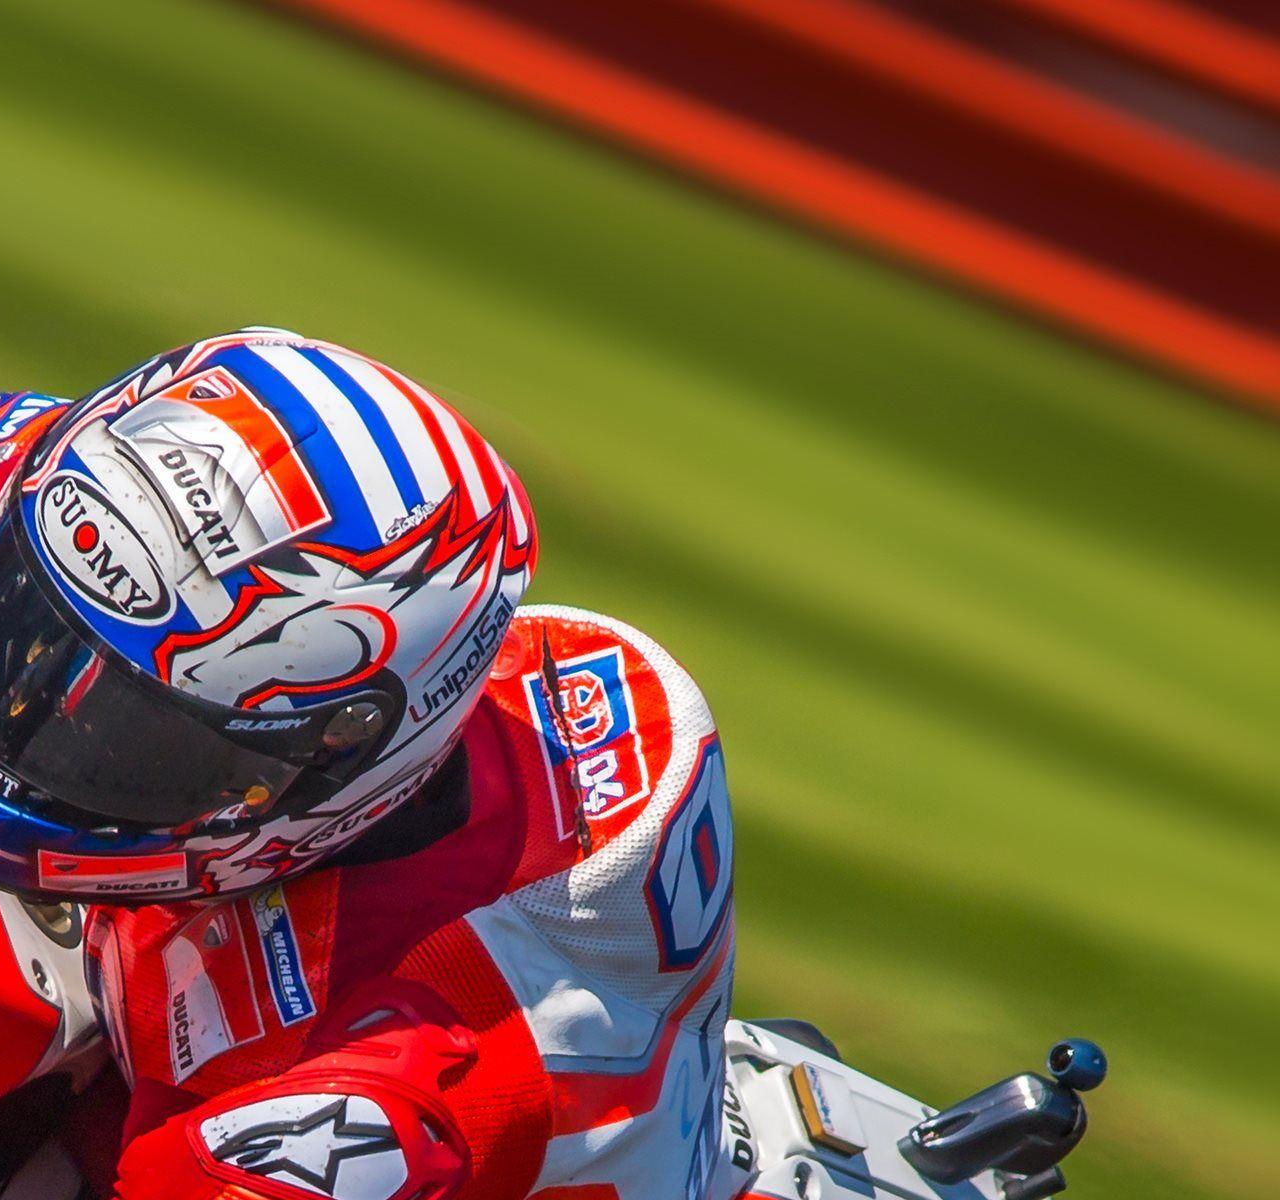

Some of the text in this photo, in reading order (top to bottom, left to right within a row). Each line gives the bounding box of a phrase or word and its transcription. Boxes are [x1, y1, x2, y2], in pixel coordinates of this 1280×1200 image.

[158, 446, 240, 560] DUCATI
[52, 478, 153, 616] SUOMY
[408, 592, 514, 724] UnipolSai
[310, 765, 437, 847] SUOM
[576, 749, 625, 813] 04
[95, 879, 180, 893] DUCATI
[272, 931, 303, 1016] MICHELIN
[171, 991, 194, 1071] DUCATI
